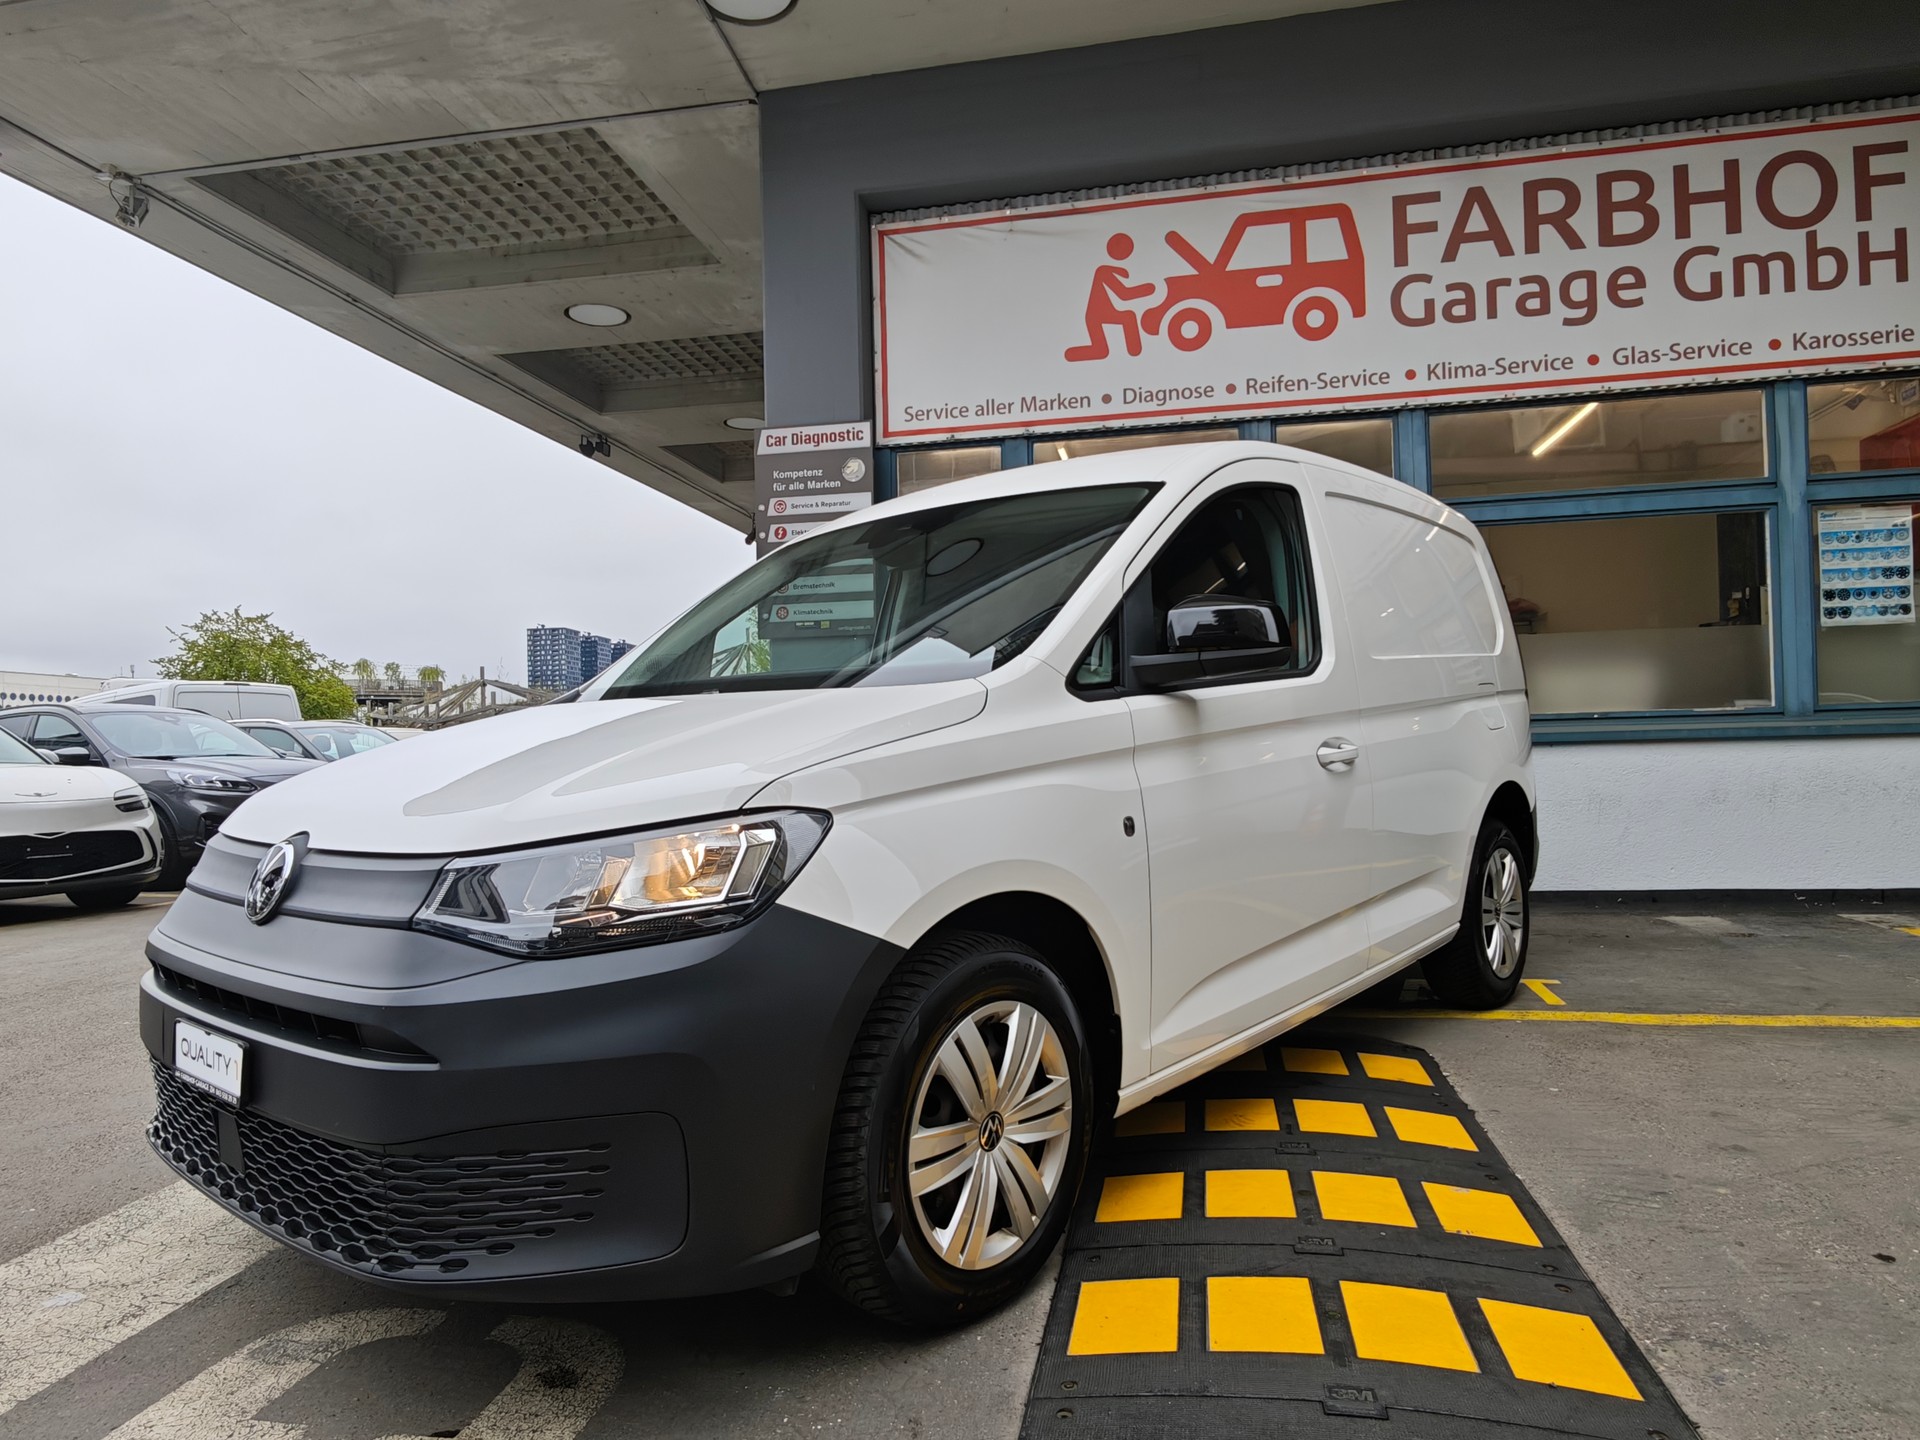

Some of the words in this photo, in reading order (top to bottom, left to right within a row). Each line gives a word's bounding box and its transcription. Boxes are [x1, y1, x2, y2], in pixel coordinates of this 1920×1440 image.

[1391, 140, 1910, 268] FARBHOF
[1390, 265, 1648, 328] Garage
[1672, 226, 1910, 302] GmbH
[904, 405, 970, 423] Service
[974, 398, 1015, 417] aller
[1020, 392, 1092, 414] Marken
[1122, 384, 1215, 406] Diagnose
[1246, 369, 1391, 396] Reifen-Service
[1427, 355, 1574, 382] Klima-Service
[1612, 340, 1753, 367] Glas-Service
[1792, 325, 1916, 352] Karosserie
[766, 434, 788, 448] Car
[791, 427, 864, 448] Diagnostic
[773, 468, 823, 480] Kompetenz
[773, 482, 786, 492] für
[789, 481, 805, 491] alle
[807, 480, 841, 490] Marken
[791, 502, 814, 510] Service
[793, 582, 835, 590] Bremstechnik
[181, 1037, 231, 1076] QUALITY
